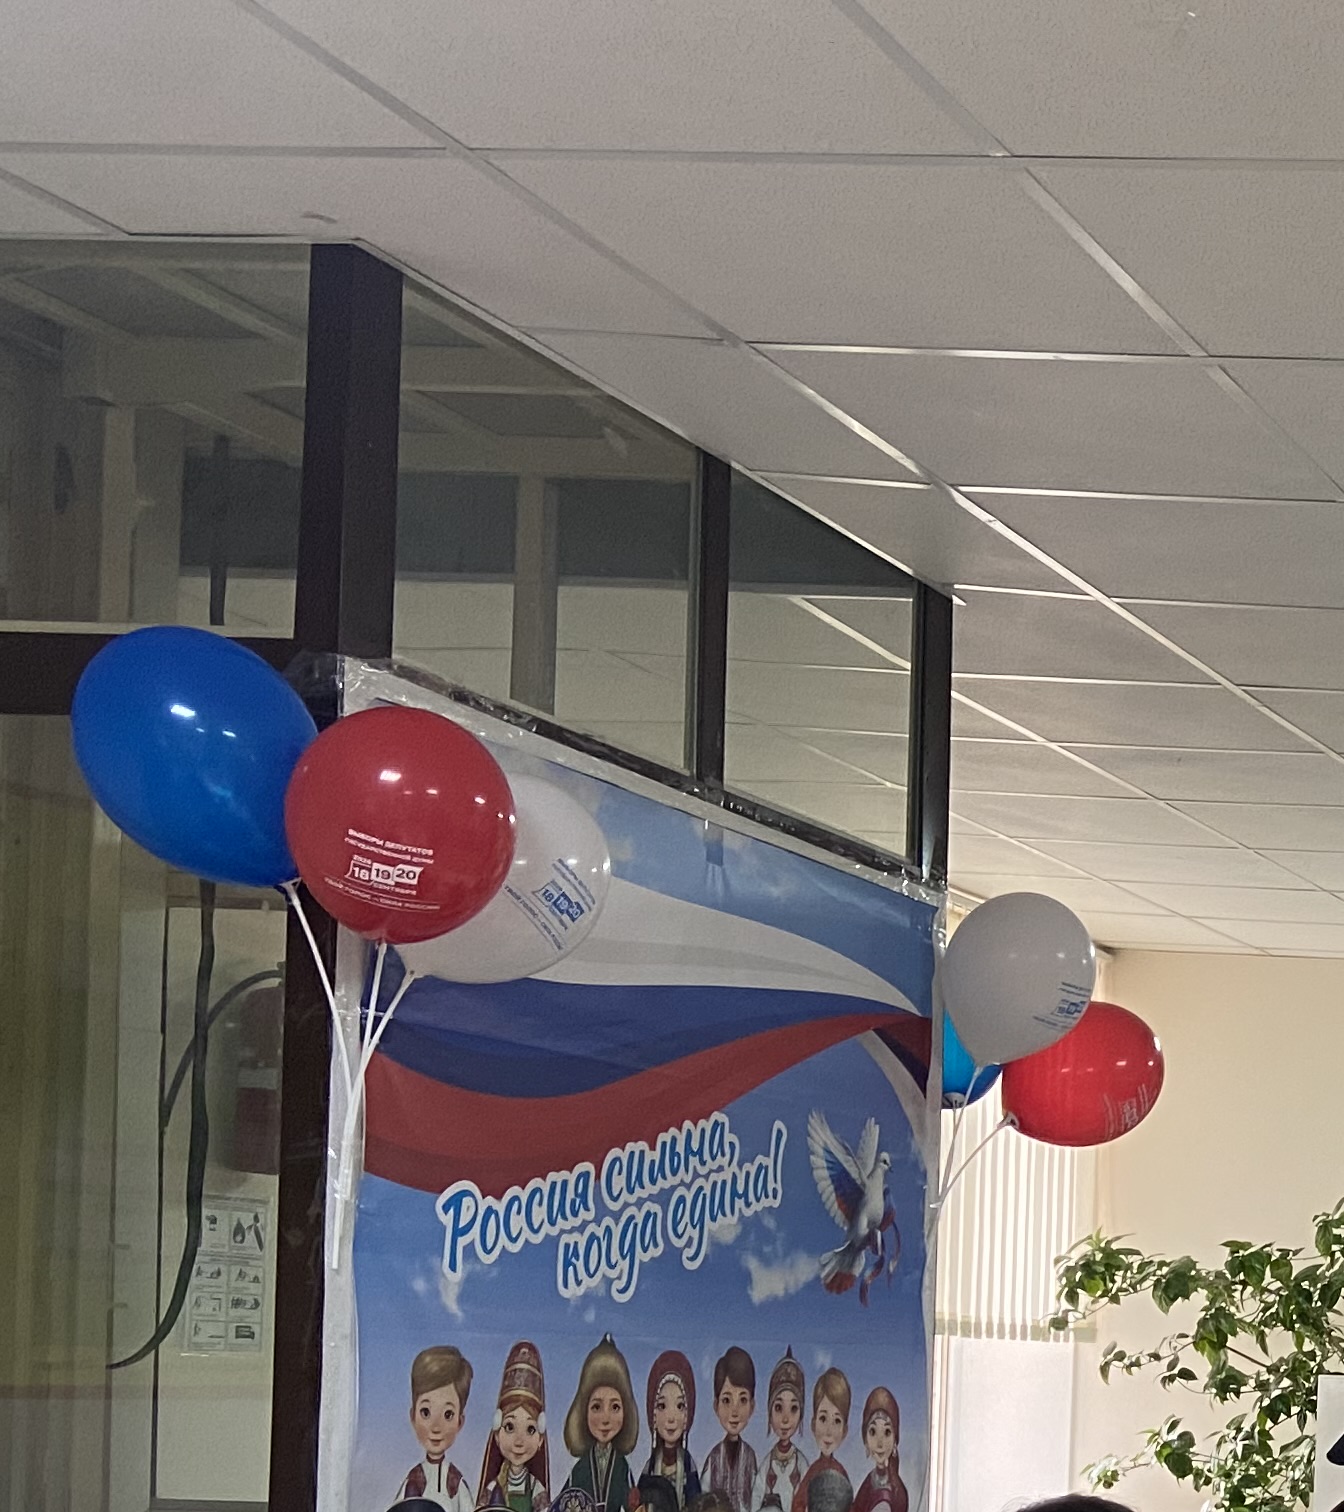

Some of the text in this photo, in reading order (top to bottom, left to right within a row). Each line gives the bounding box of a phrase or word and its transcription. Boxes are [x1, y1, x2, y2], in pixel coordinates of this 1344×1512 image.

[353, 867, 416, 881] 18 19 20
[441, 1118, 737, 1274] Россия сильна,
[562, 1127, 784, 1295] когда едина!
